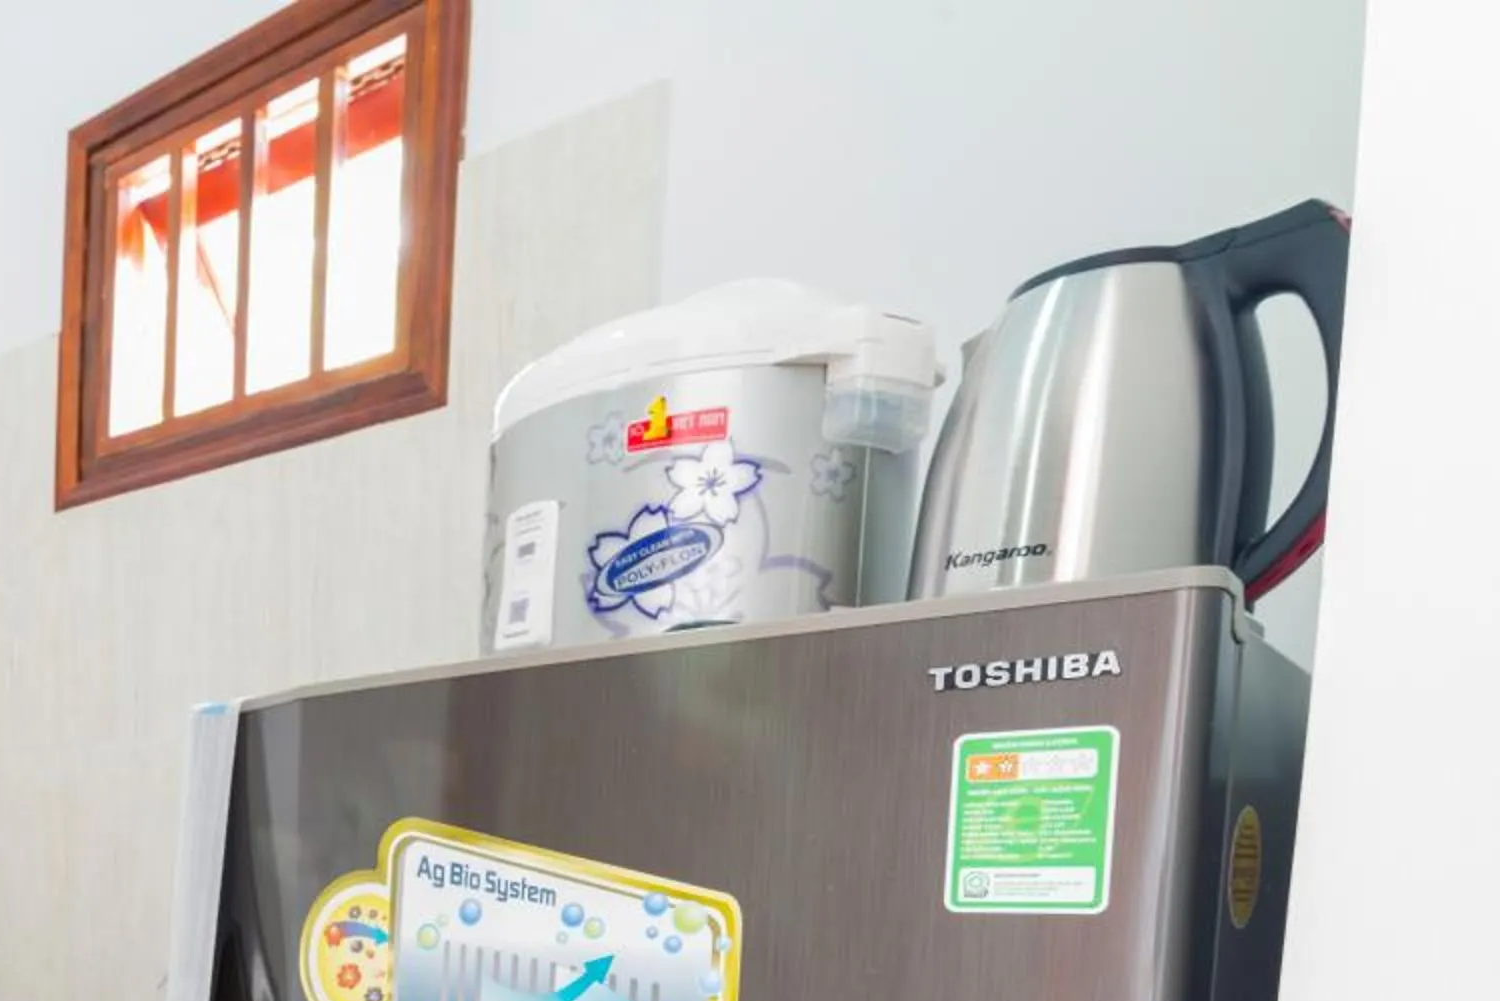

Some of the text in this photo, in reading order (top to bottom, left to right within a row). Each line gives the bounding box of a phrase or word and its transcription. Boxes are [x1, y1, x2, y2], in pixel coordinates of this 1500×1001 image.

[944, 543, 1048, 571] Kangaroo
[928, 649, 1122, 691] TOSHIBA
[416, 855, 557, 907] Ag Bio System
